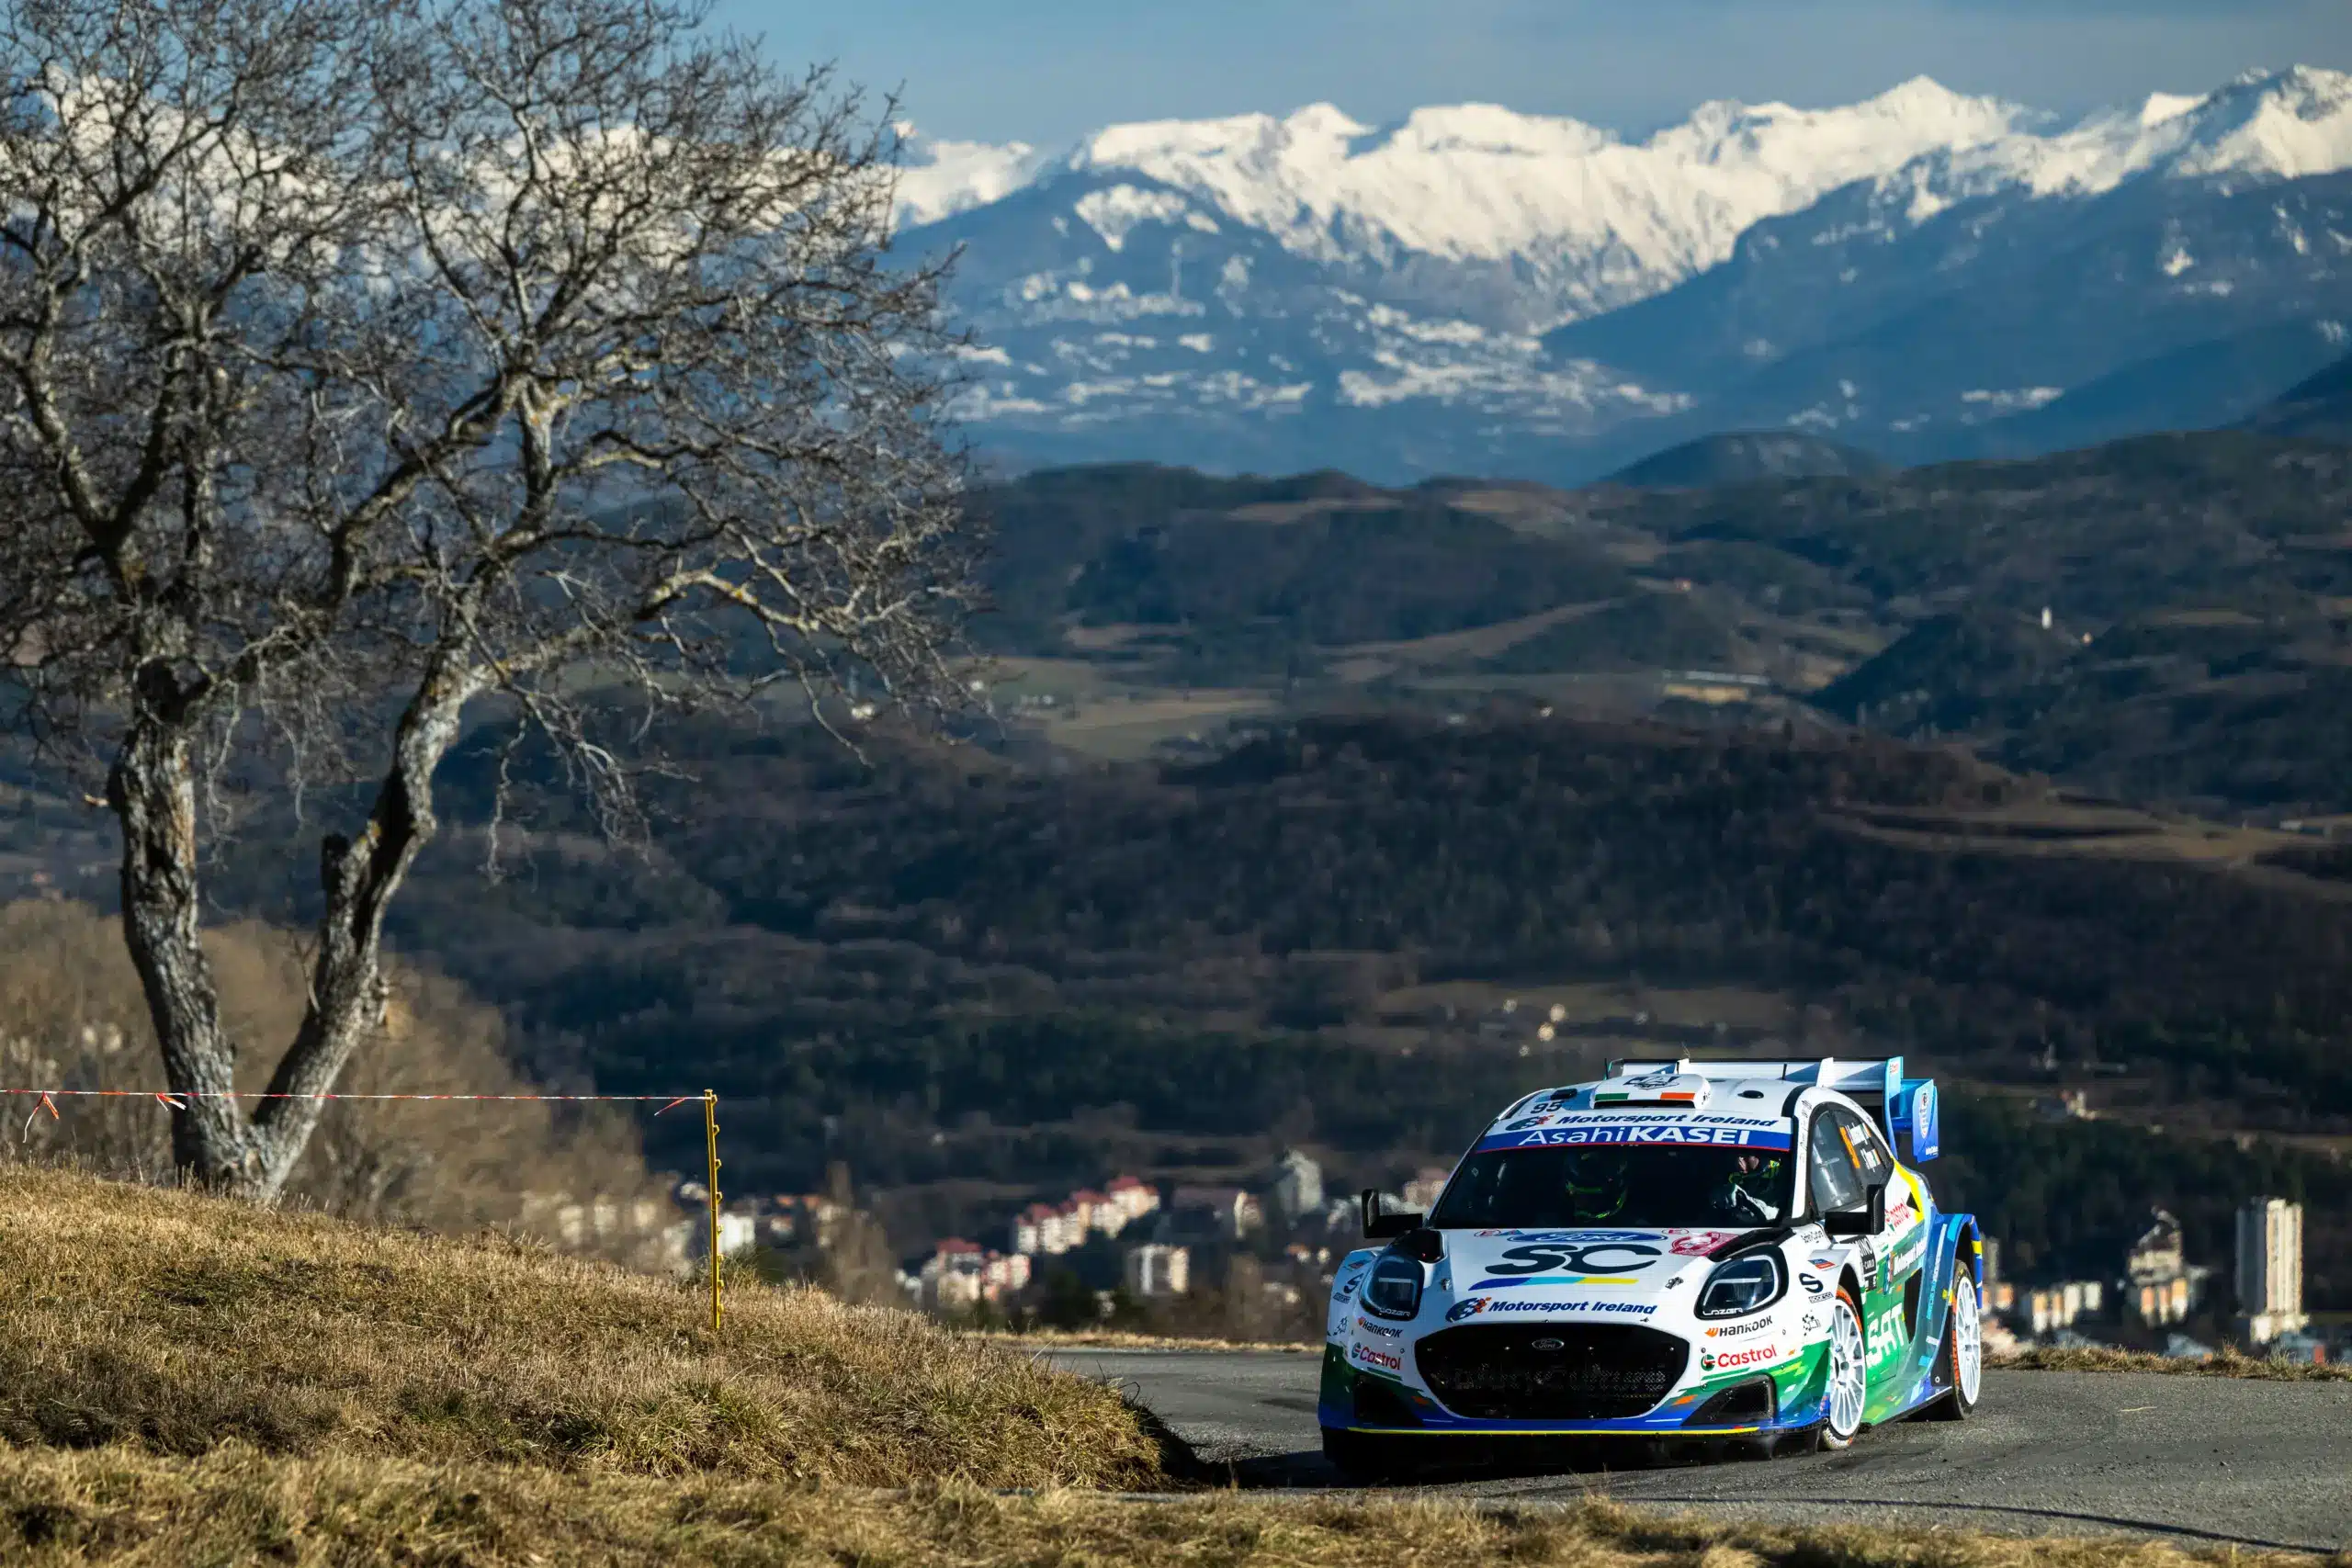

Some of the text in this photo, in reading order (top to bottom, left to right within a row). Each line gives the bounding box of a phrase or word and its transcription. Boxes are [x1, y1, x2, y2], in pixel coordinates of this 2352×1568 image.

[1530, 1100, 1565, 1114] 95
[1555, 1113, 1779, 1127] Motorsport Ireland
[1535, 1232, 1639, 1242] Ford
[1485, 1244, 1663, 1275] SC
[1488, 1301, 1657, 1314] Motorsport Ireland
[1360, 1346, 1401, 1371] Castrol
[1717, 1344, 1777, 1368] Castrol
